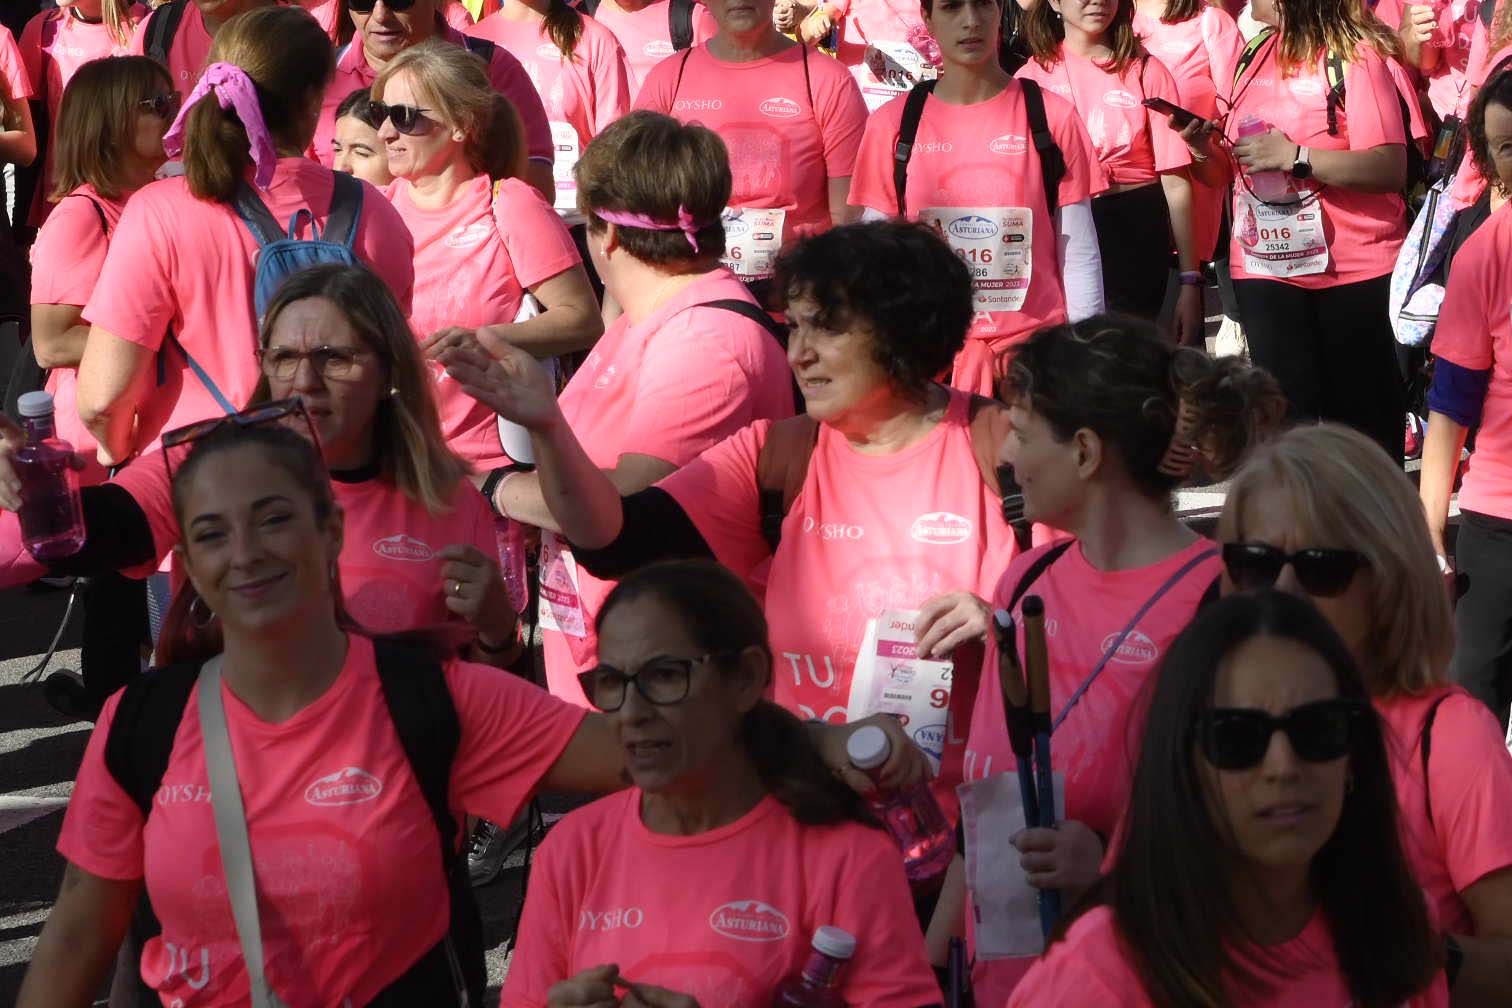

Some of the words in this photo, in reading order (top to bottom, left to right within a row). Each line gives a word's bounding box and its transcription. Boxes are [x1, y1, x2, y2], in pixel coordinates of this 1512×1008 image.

[675, 99, 723, 112] OYSHO
[951, 223, 997, 235] ASTURIANA
[1260, 227, 1291, 240] 016
[1265, 242, 1290, 251] 25342
[980, 281, 1004, 289] MUJER
[783, 652, 834, 688] TU
[717, 913, 786, 936] ASTURIANA
